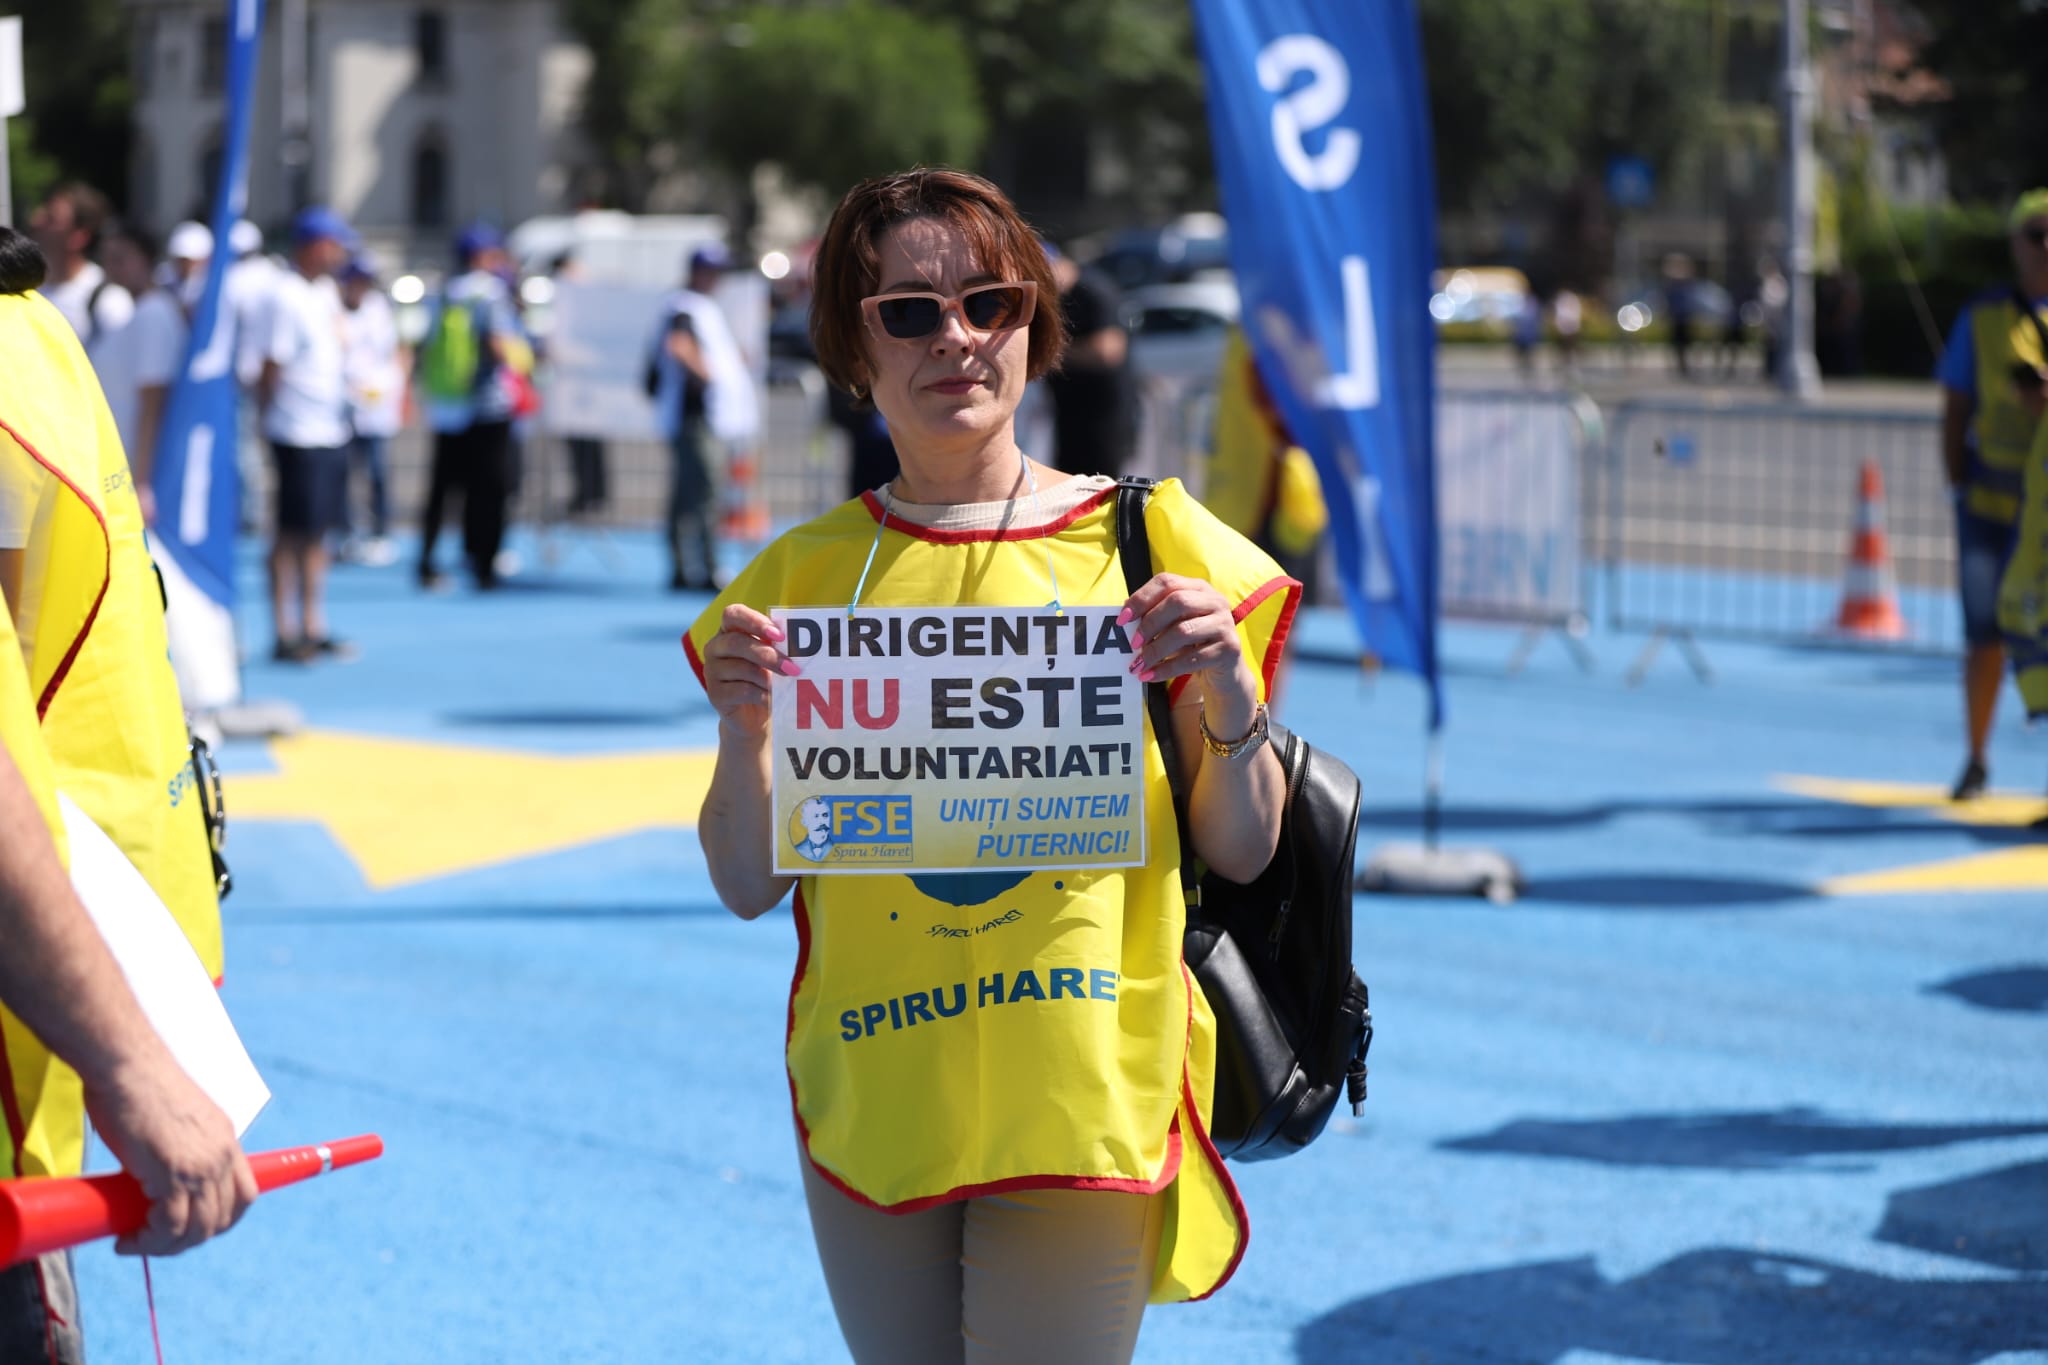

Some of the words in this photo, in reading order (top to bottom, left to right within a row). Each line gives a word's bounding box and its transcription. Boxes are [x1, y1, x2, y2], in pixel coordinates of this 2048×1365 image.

[786, 615, 1133, 670] DIRIGENȚIA
[796, 679, 900, 730] NU
[931, 676, 1124, 730] ESTE
[786, 743, 1131, 780] VOLUNTARIAT!
[832, 801, 910, 836] FSE
[939, 799, 1010, 830] UNIȚI
[1017, 794, 1130, 822] SUNTEM
[833, 846, 867, 860] Spiru
[870, 844, 910, 858] Haret
[976, 830, 1130, 858] PUTERNICI!
[925, 924, 974, 938] SPIRU
[840, 983, 968, 1042] SPIRU
[977, 968, 1120, 1008] HARE
